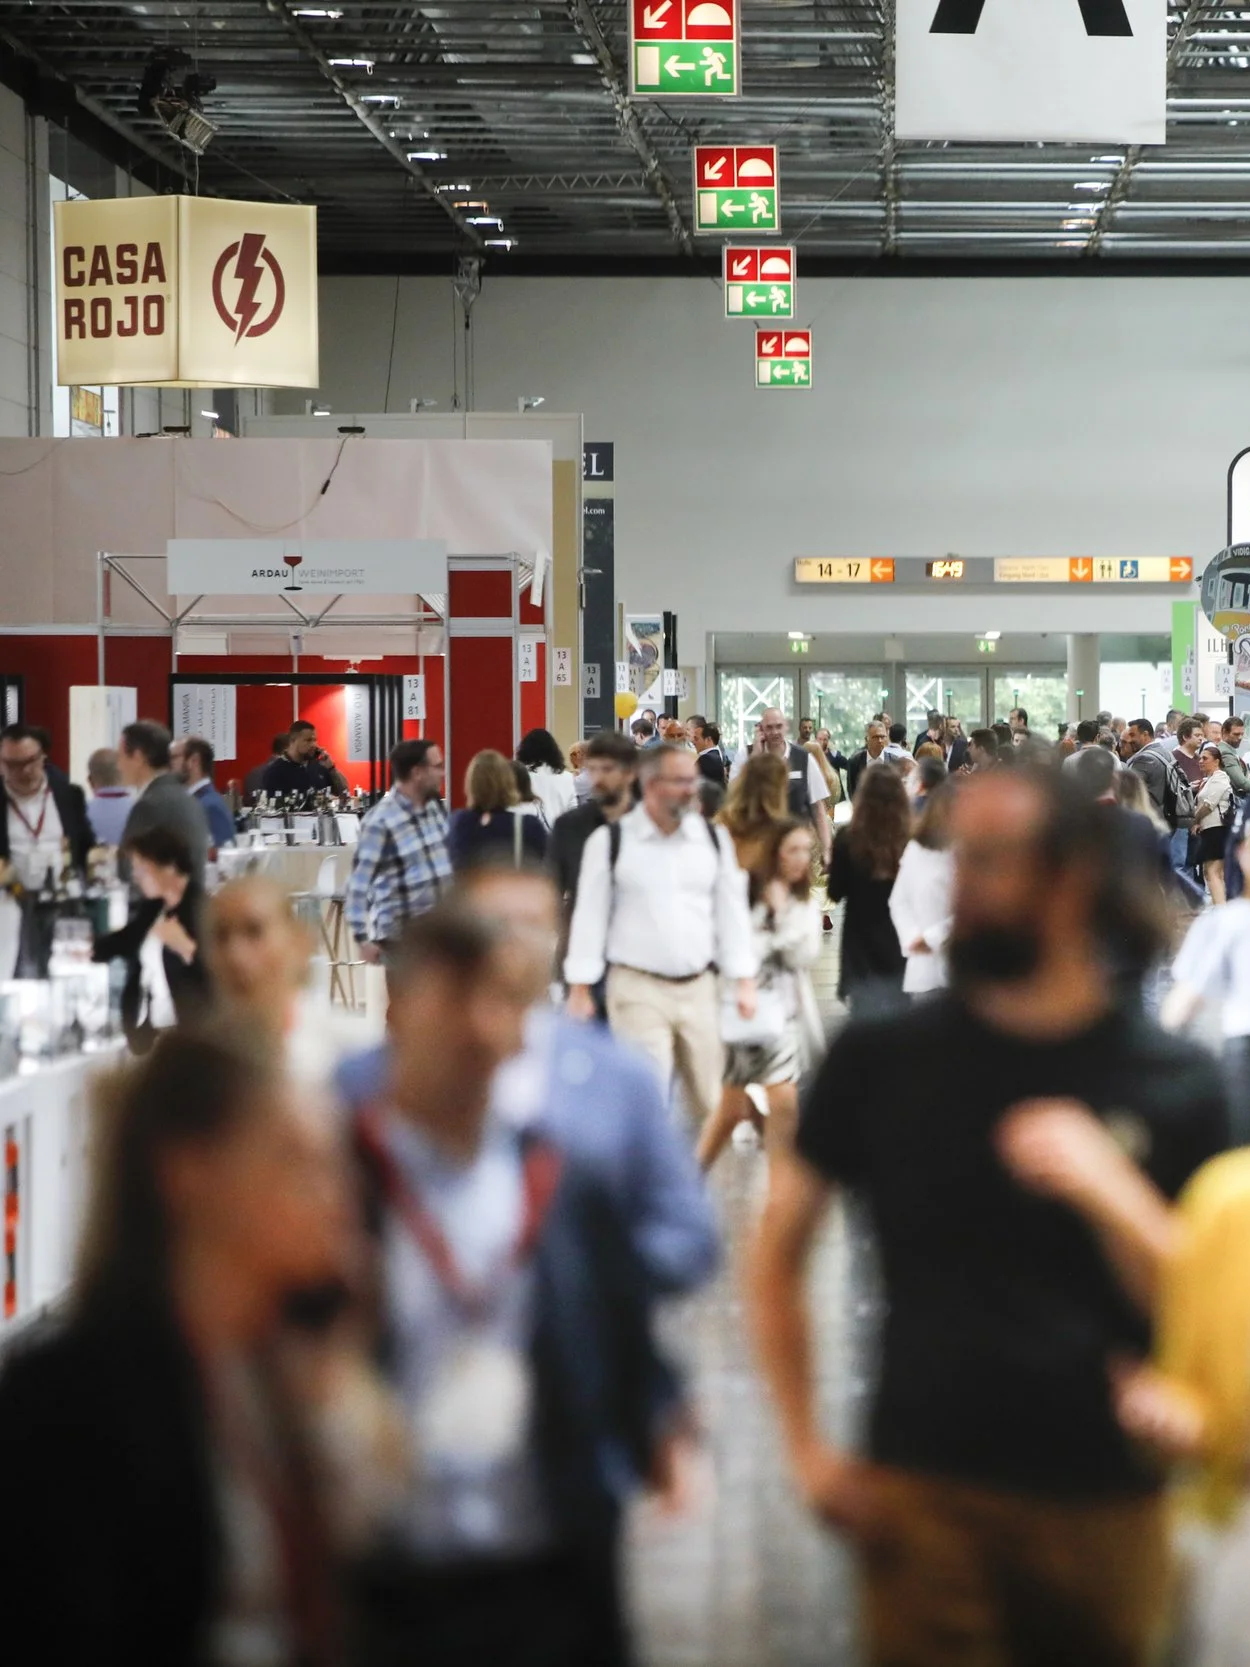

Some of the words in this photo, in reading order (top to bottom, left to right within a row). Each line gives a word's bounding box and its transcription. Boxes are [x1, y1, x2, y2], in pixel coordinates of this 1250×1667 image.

[63, 242, 167, 287] CASA
[64, 294, 165, 340] ROJO
[252, 569, 289, 578] ARDAU
[299, 569, 365, 578] WEINIMPORT
[817, 563, 833, 577] 14
[847, 563, 861, 577] 17
[522, 644, 531, 653] 13
[557, 651, 567, 659] 13
[522, 669, 531, 678] 71
[587, 666, 596, 674] 13
[556, 674, 567, 682] 65
[588, 677, 594, 685] A
[408, 679, 419, 688] 13
[586, 687, 596, 695] 61
[410, 693, 417, 701] A
[408, 705, 419, 715] 81
